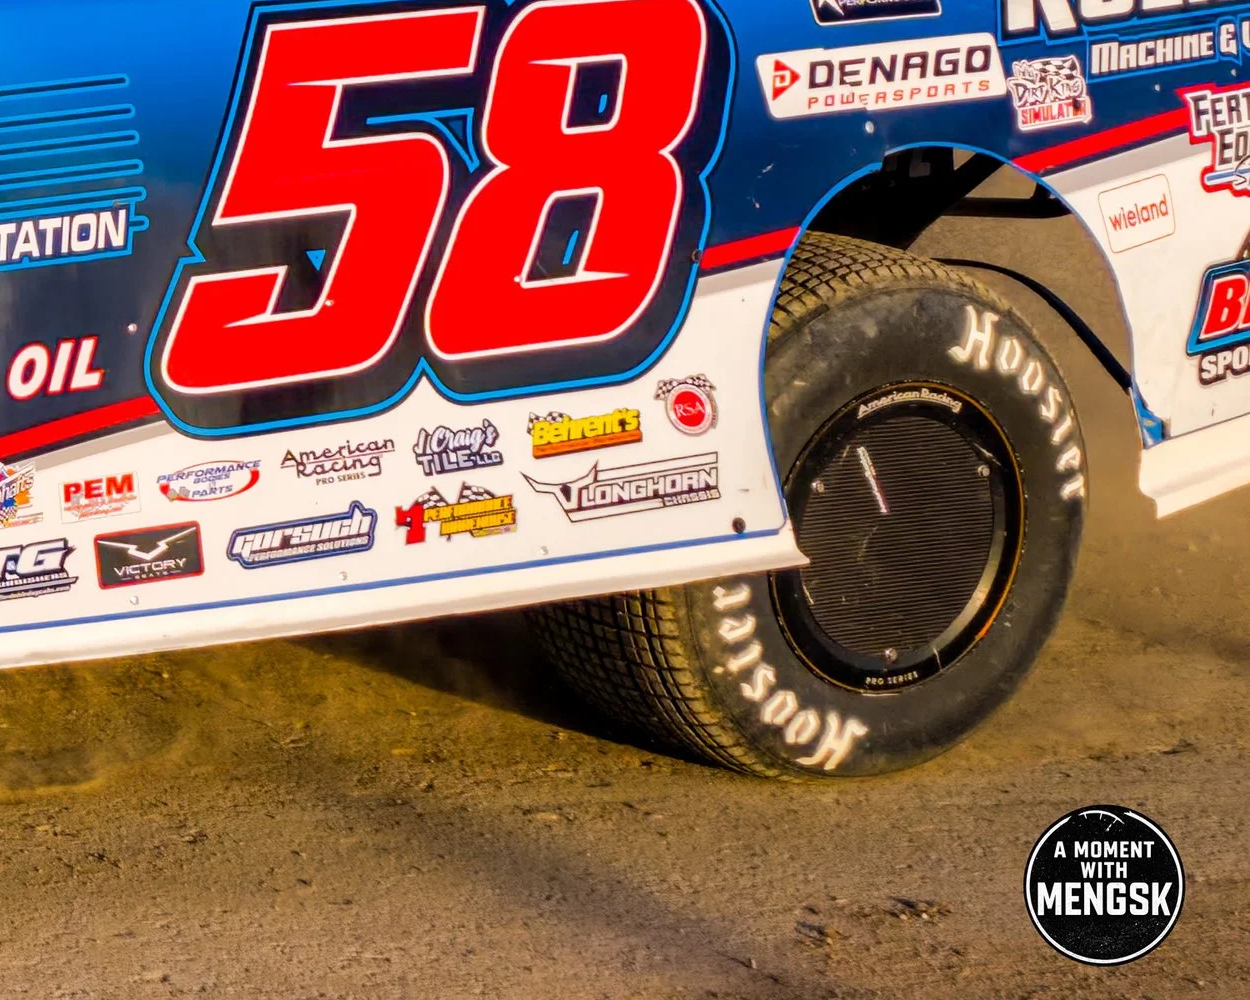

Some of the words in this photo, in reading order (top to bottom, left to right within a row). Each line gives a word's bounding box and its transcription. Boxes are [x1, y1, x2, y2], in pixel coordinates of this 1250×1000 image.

[808, 44, 992, 90] DENAGO
[808, 80, 991, 109] POWERSPORTS
[1109, 193, 1169, 233] wieland
[6, 336, 103, 401] OIL
[675, 401, 705, 418] RSA
[949, 304, 1086, 500] Hoosier
[280, 438, 396, 469] American
[297, 454, 382, 479] Racing
[156, 459, 262, 484] PERFORMANCE
[316, 476, 335, 486] PRO
[337, 471, 366, 483] SERIES
[581, 466, 719, 507] LONGHORN
[63, 472, 134, 503] PEM
[191, 484, 234, 498] PARTS
[113, 557, 187, 577] VICTORY
[712, 582, 870, 771] Hoosier
